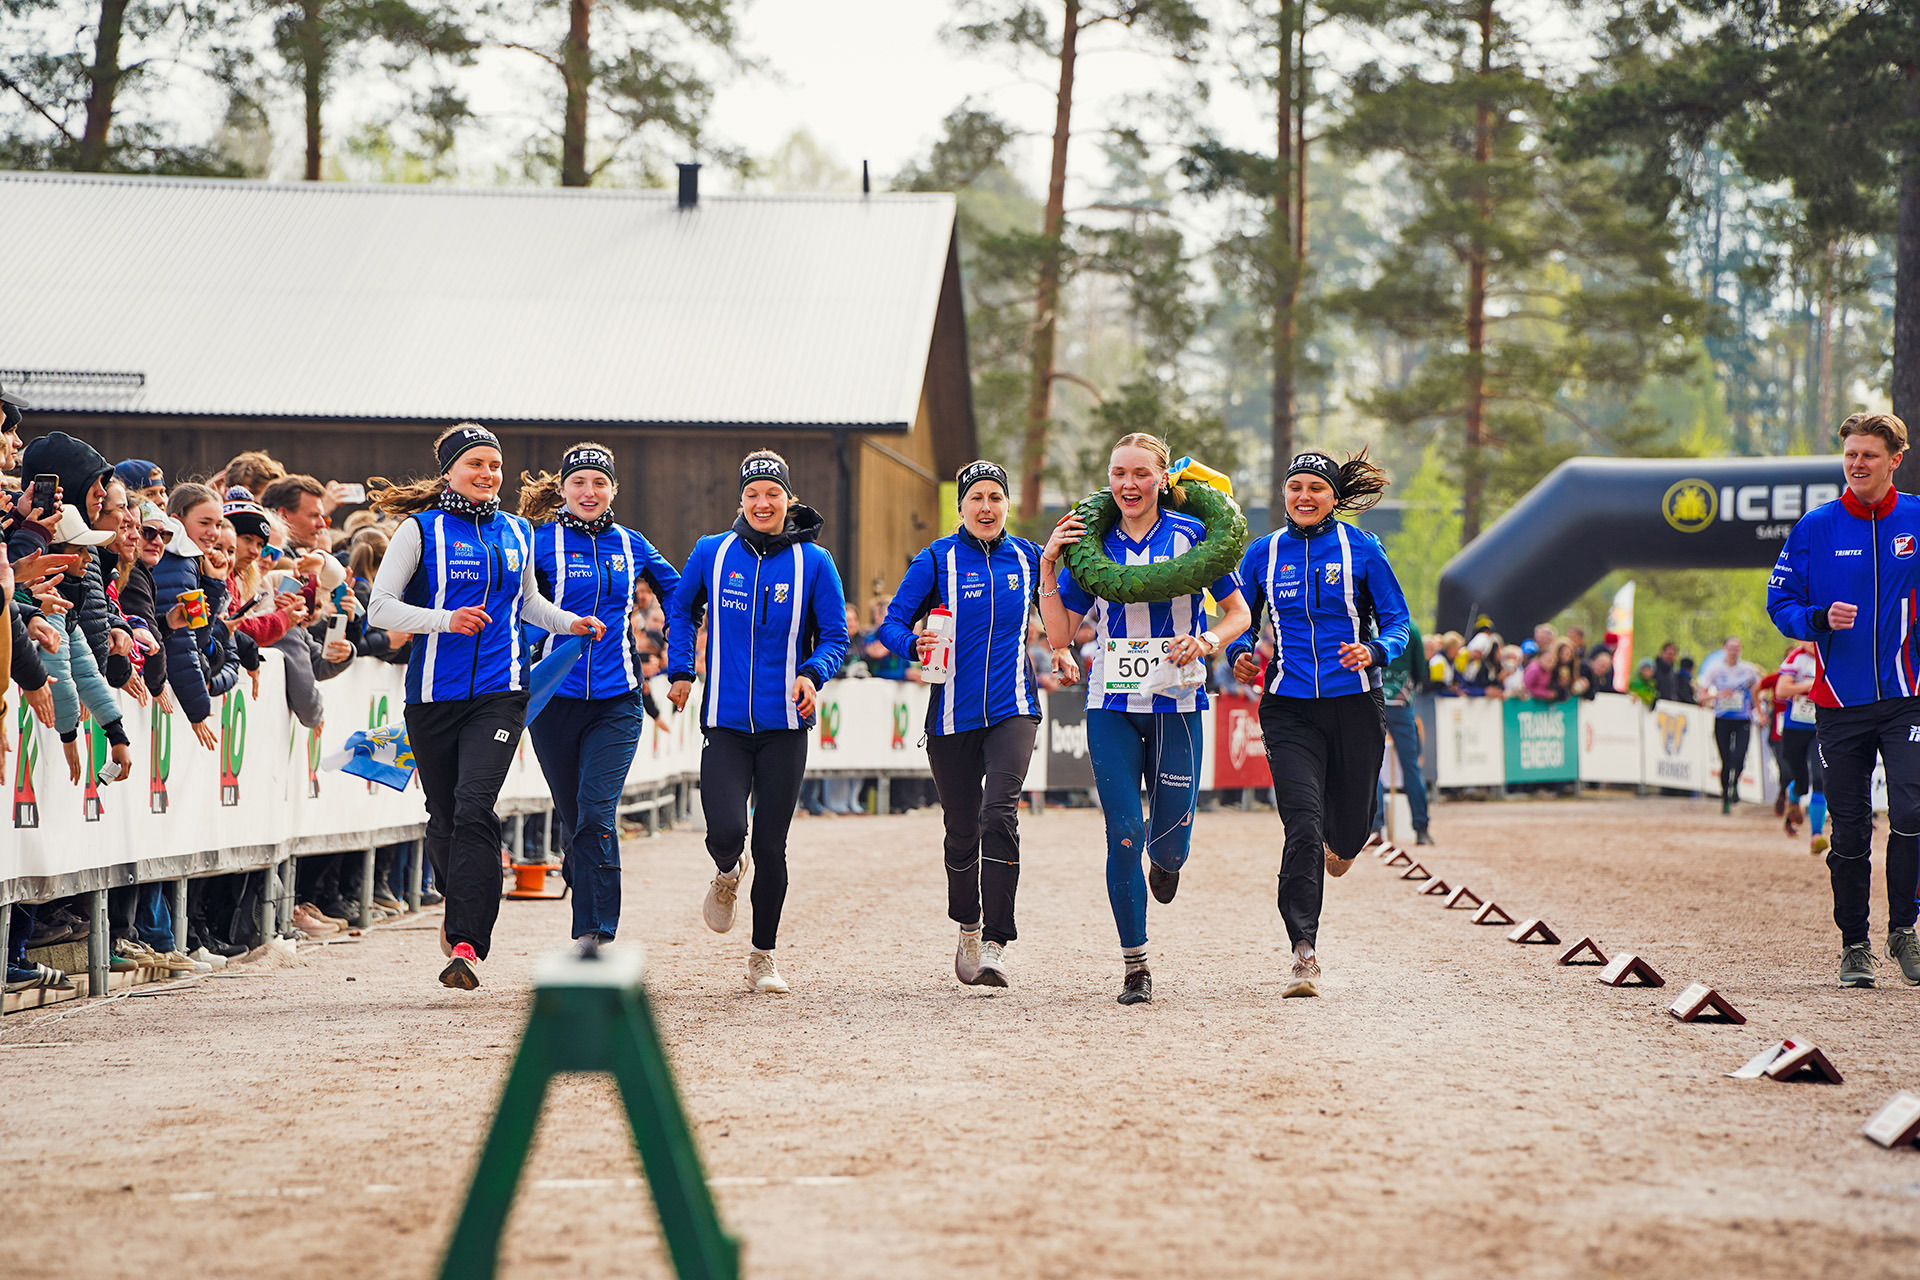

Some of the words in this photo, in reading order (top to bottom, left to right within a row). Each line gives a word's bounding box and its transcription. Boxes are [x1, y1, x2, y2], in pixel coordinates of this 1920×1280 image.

[742, 459, 781, 477] LEDX
[1834, 549, 1863, 557] TRIMTEX
[450, 568, 479, 580] barku
[722, 588, 748, 597] noname
[721, 596, 748, 611] barku
